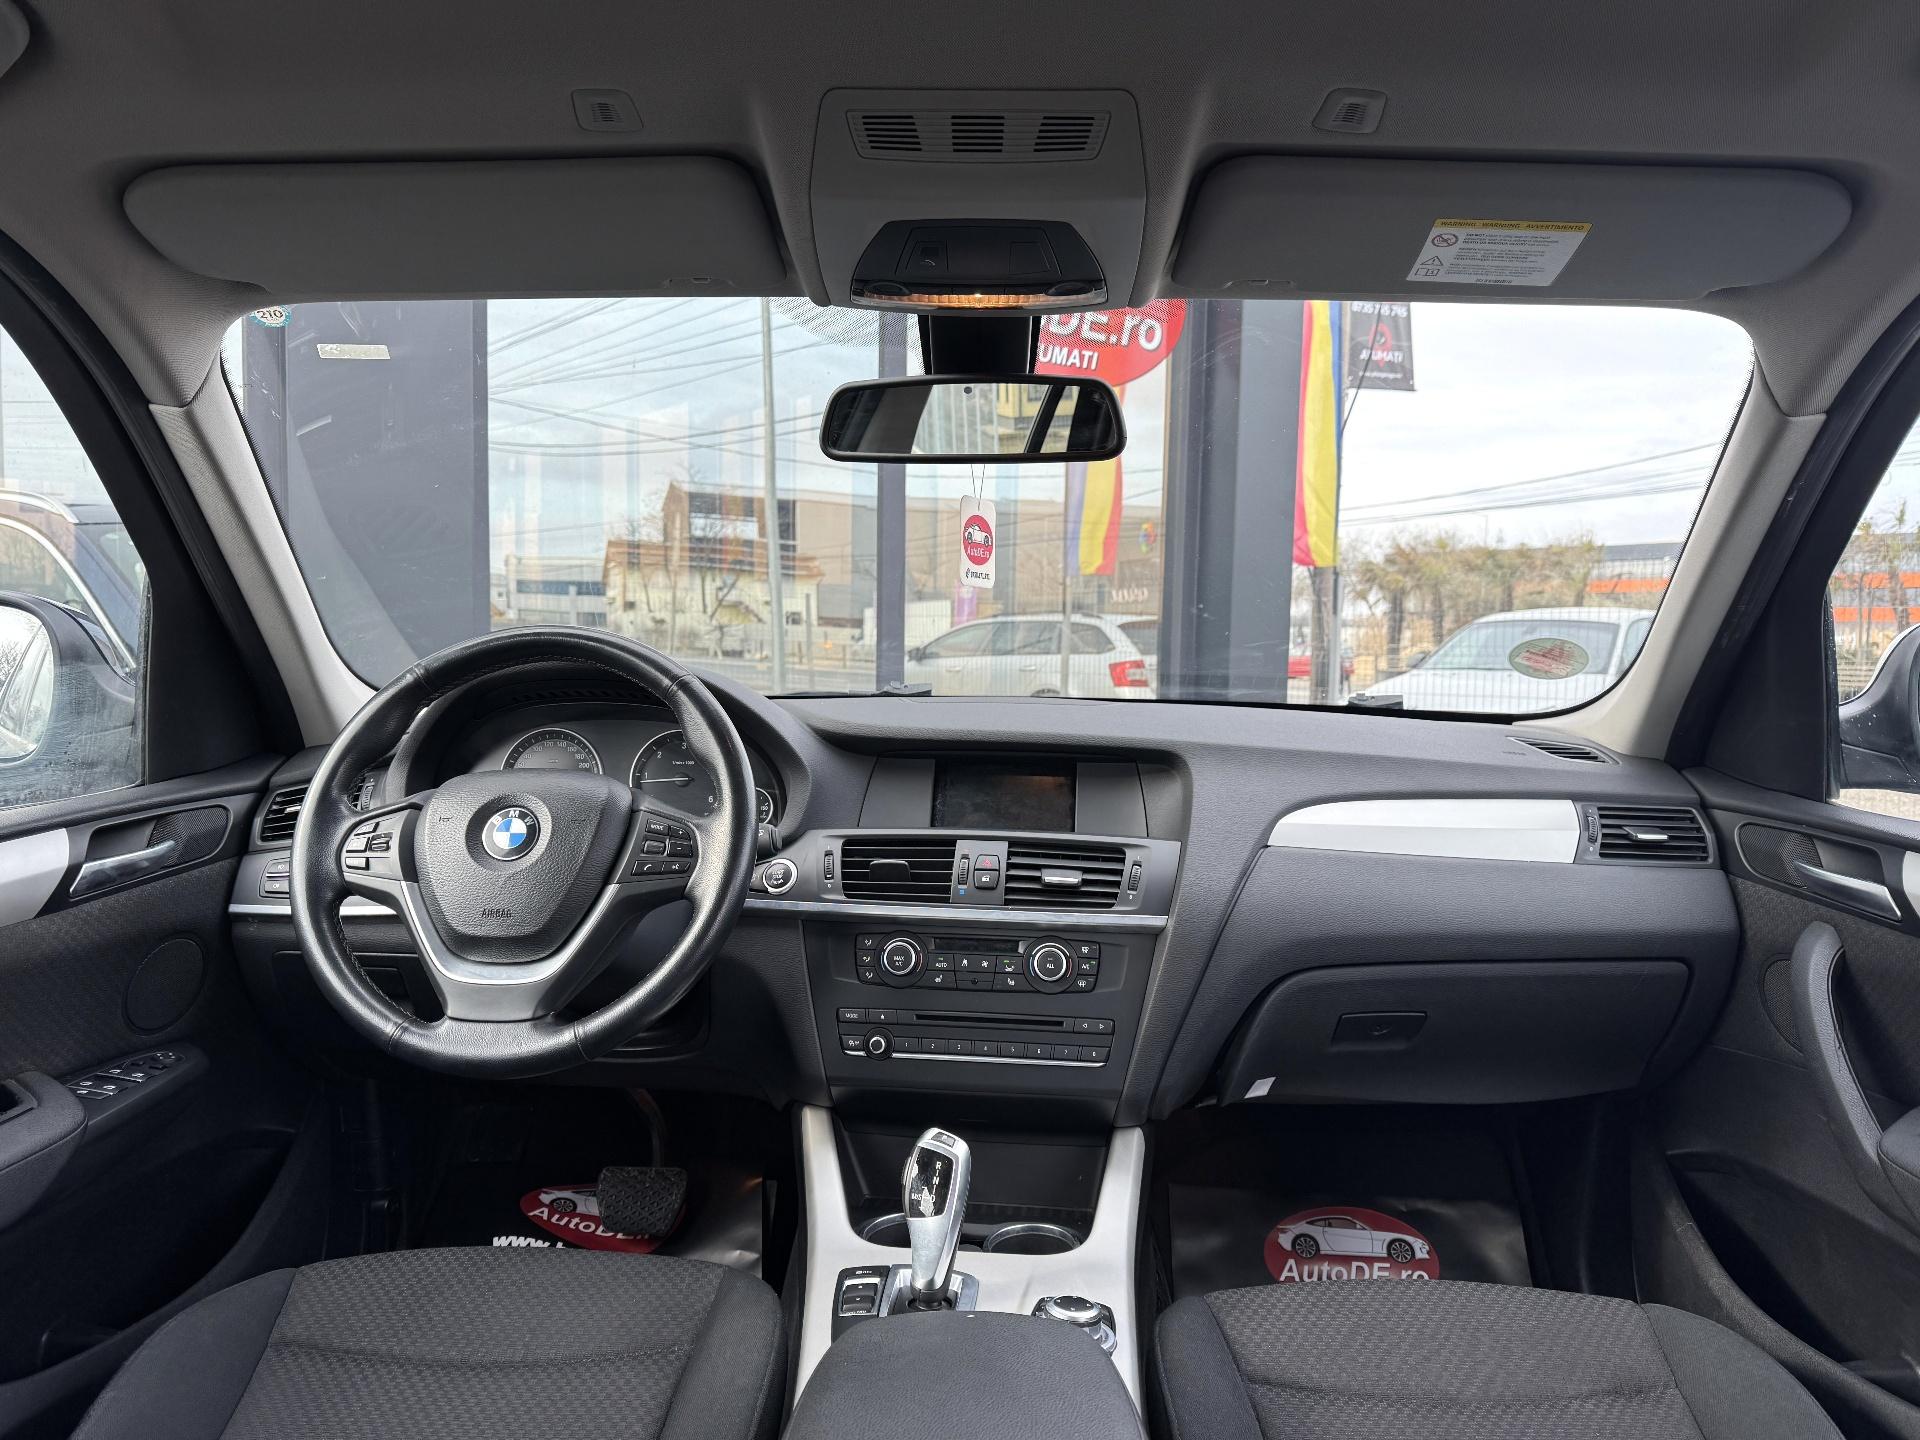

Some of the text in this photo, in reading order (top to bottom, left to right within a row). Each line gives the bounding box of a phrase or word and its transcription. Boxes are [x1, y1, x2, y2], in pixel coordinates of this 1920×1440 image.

[1041, 312, 1163, 351] DE.ro
[1040, 343, 1098, 370] UMATI
[482, 909, 512, 918] AIRBAG
[936, 1161, 942, 1169] R
[933, 1176, 939, 1185] N
[1279, 1258, 1429, 1282] AutoDEro
